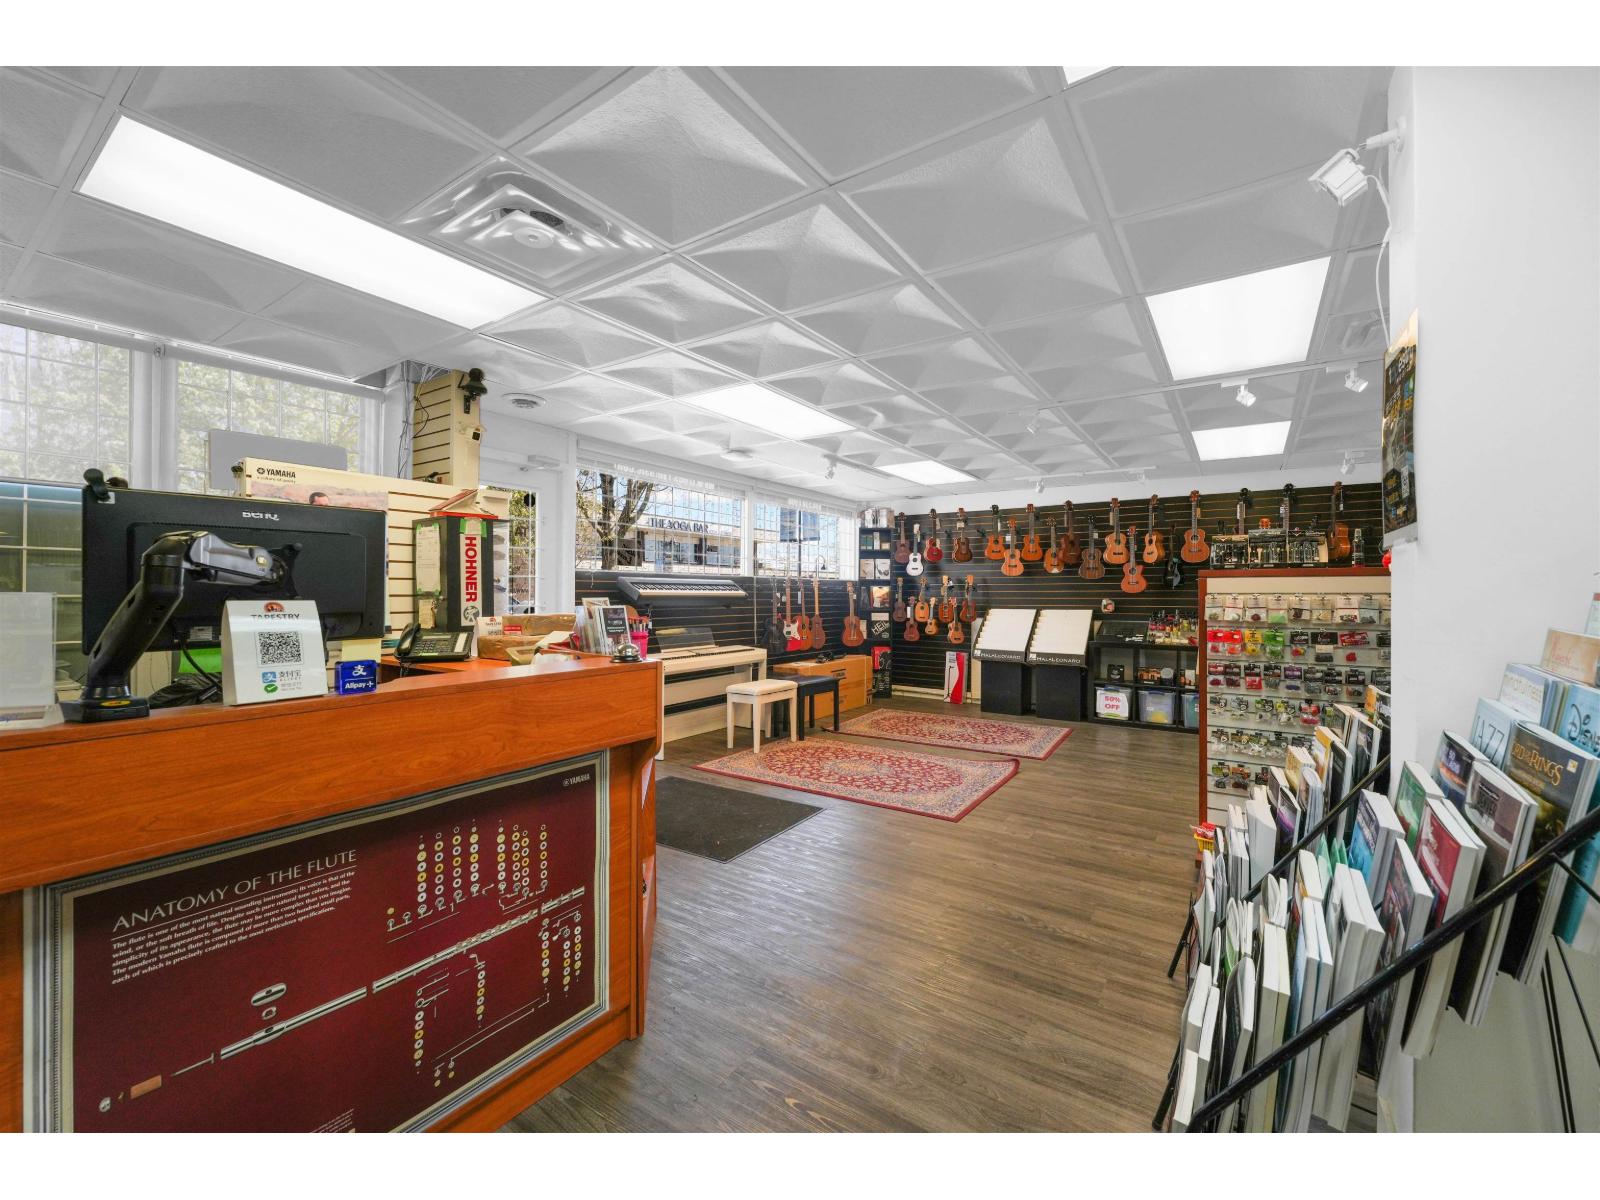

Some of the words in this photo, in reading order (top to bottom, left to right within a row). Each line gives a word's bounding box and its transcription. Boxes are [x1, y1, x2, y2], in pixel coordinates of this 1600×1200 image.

[266, 468, 296, 479] YAMAHA
[650, 517, 666, 529] THE
[693, 522, 709, 534] BAR
[464, 536, 478, 603] HOHNER
[569, 773, 591, 785] YAMAHA
[1529, 750, 1564, 786] RINGS
[113, 886, 229, 932] ANATOMY
[234, 876, 261, 895] OF
[267, 865, 302, 885] THE
[307, 849, 357, 874] FLUTE
[129, 935, 146, 944] flute
[192, 916, 208, 924] most
[210, 907, 233, 919] natural
[234, 900, 262, 911] sounding
[308, 880, 321, 889] voice
[160, 936, 173, 944] soft
[174, 927, 196, 938] breath
[221, 912, 244, 923] Despite
[246, 907, 260, 915] such
[262, 903, 276, 914] pure
[276, 895, 296, 906] natural
[112, 952, 148, 967] simplicity
[224, 922, 240, 930] flute
[281, 902, 304, 914] complex
[306, 897, 317, 905] than
[112, 975, 130, 985] each
[142, 963, 164, 974] which
[173, 950, 204, 964] precisely
[205, 943, 228, 953] crafted
[249, 928, 264, 937] most
[265, 919, 297, 932] meticulous
[128, 957, 157, 970] modern
[159, 947, 186, 959] Yamaha
[188, 942, 203, 950] flute
[212, 928, 244, 941] composed
[253, 920, 269, 929] more
[297, 903, 320, 914] hundred
